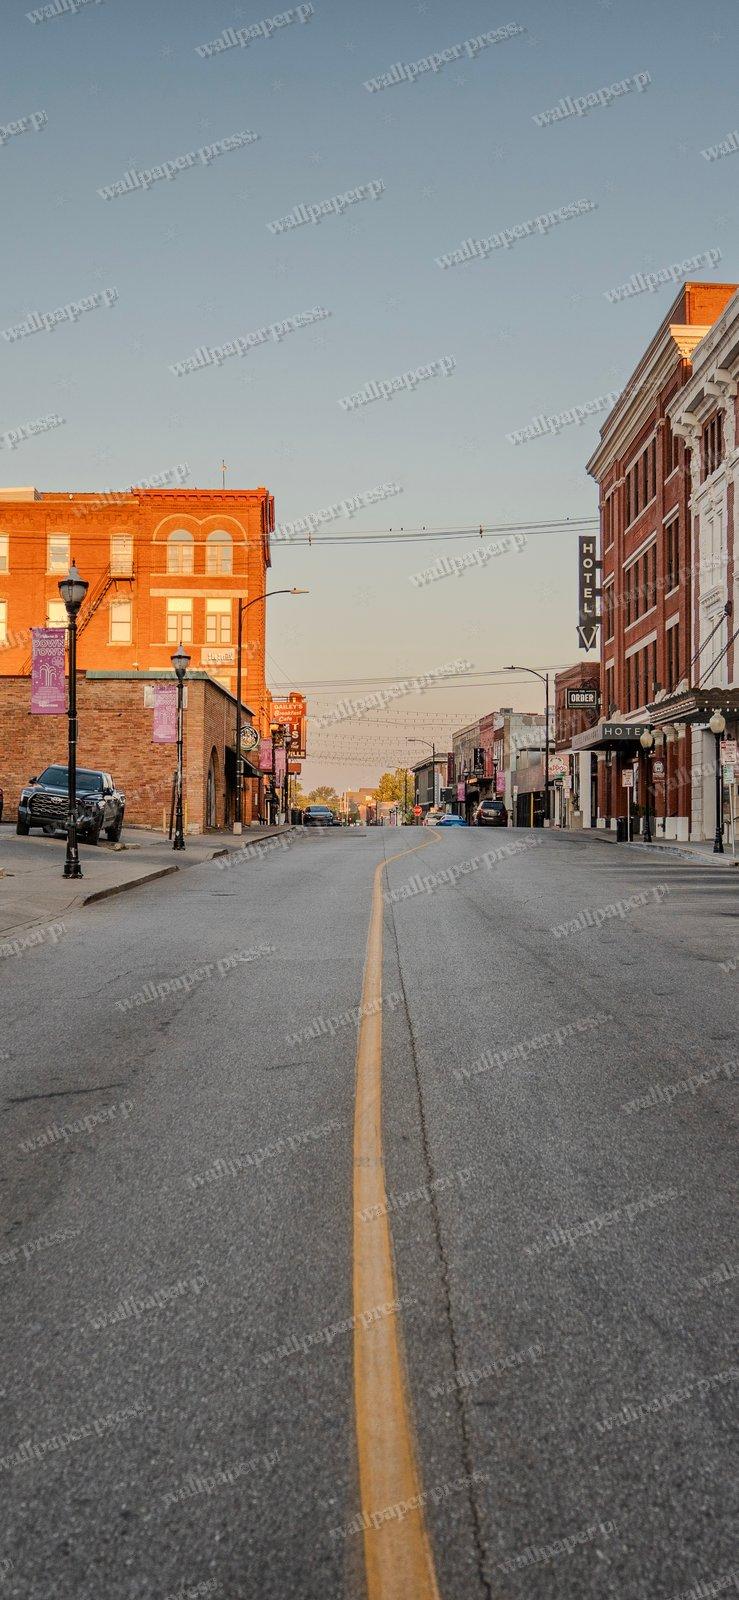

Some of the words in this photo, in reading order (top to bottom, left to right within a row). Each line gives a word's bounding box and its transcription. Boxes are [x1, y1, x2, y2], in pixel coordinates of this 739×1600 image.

[583, 543, 593, 613] HOTEL
[577, 626, 599, 651] V
[571, 694, 594, 702] ORDER
[604, 727, 642, 736] HOTE
